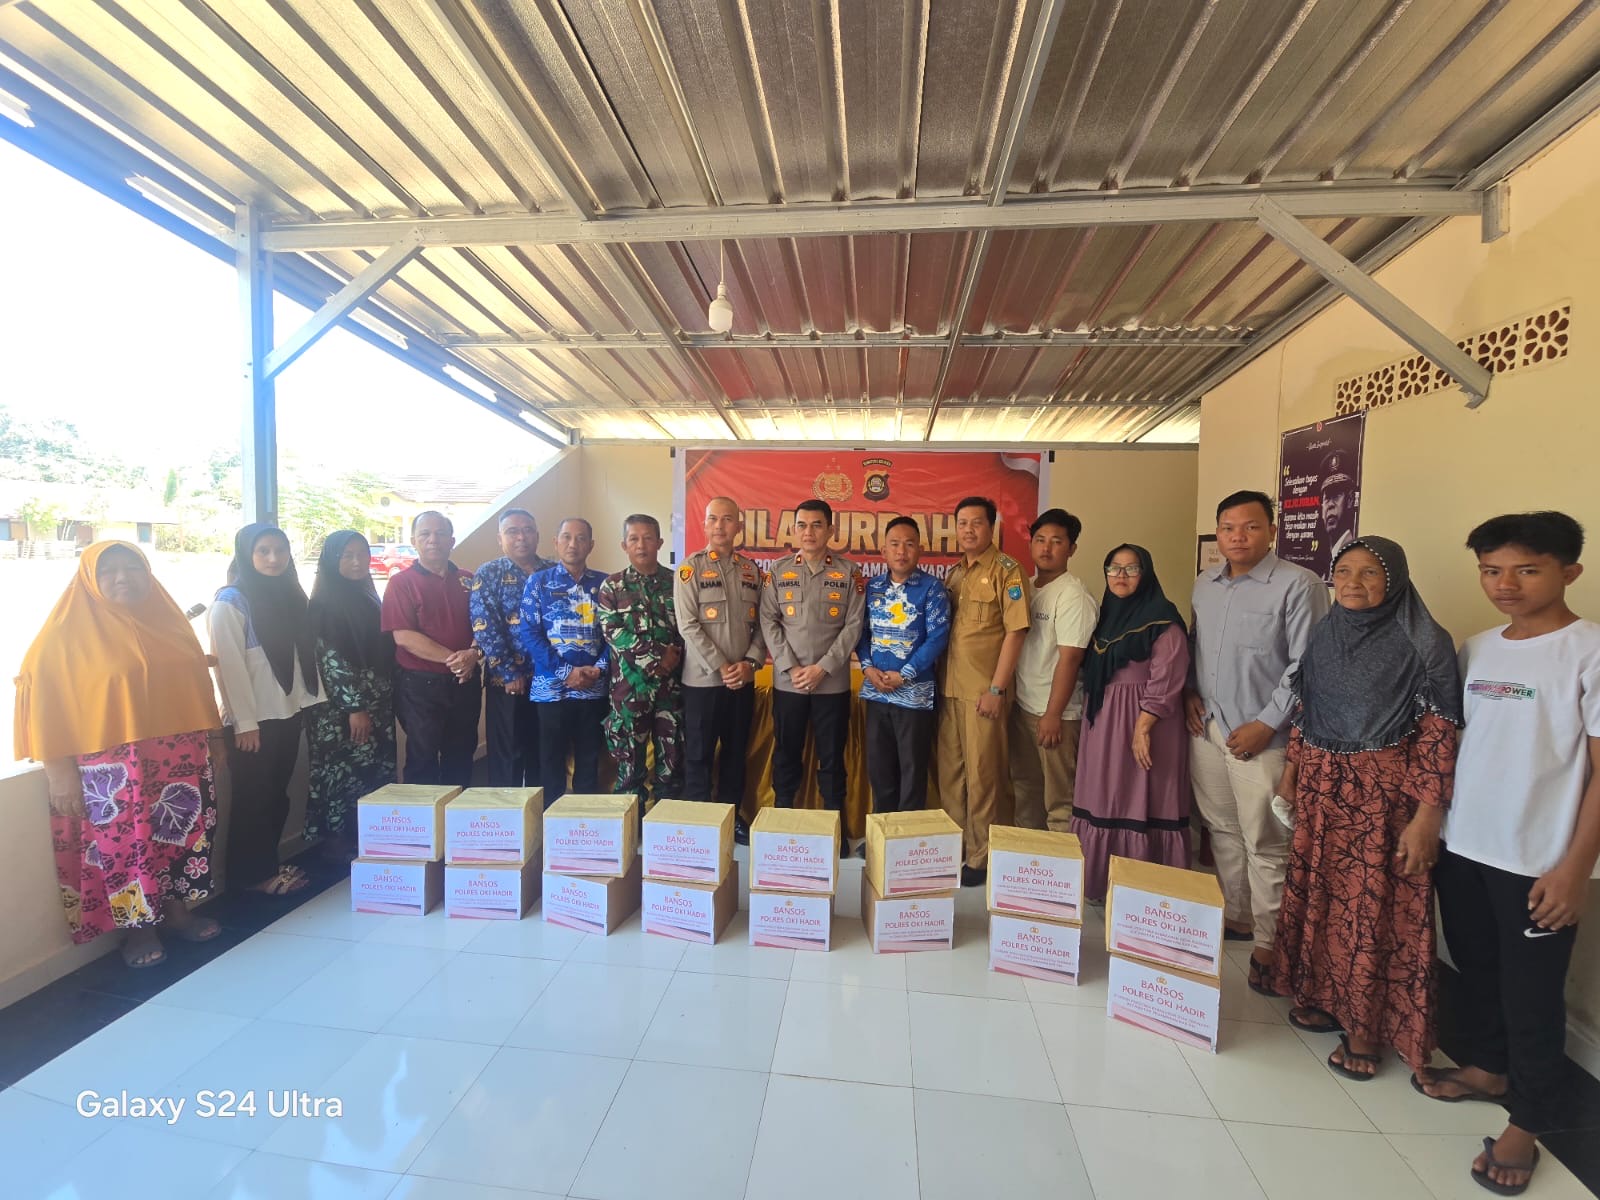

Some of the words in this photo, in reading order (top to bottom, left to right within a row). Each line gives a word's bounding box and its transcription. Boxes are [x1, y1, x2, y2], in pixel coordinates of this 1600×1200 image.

[824, 581, 848, 589] POLRI
[382, 816, 412, 824] BANSOS
[470, 821, 500, 829] BANSOS
[667, 835, 696, 845] BANSOS
[777, 845, 809, 854] BANSOS
[909, 848, 939, 856] BANSOS
[895, 859, 918, 867] POLRES
[1018, 866, 1054, 877] BANSOS
[374, 875, 402, 883] BANSOS
[1002, 874, 1030, 884] POLRES
[1047, 880, 1072, 889] HADIR
[562, 887, 588, 899] BANSOS
[551, 893, 571, 904] POLRES
[583, 901, 600, 910] HADIR
[664, 896, 692, 907] BANSOS
[652, 904, 674, 912] POLRES
[688, 910, 706, 918] HADIR
[774, 906, 806, 915] BANSOS
[900, 911, 930, 919] BANSOS
[1145, 906, 1188, 923] BANSOS
[761, 915, 784, 923] POLRES
[800, 918, 821, 926] HADIR
[1125, 913, 1157, 927] POLRES
[1160, 922, 1176, 931] OKI
[1178, 926, 1208, 939] HADIR
[1017, 932, 1053, 945] BANSOS
[1001, 940, 1028, 951] POLRES
[1031, 945, 1044, 954] OKI
[1046, 948, 1071, 958] HADIR
[1141, 980, 1184, 1001] BANSOS
[1122, 985, 1154, 1002] POLRES
[1156, 997, 1173, 1009] OKI
[1175, 1004, 1207, 1020] HADIR
